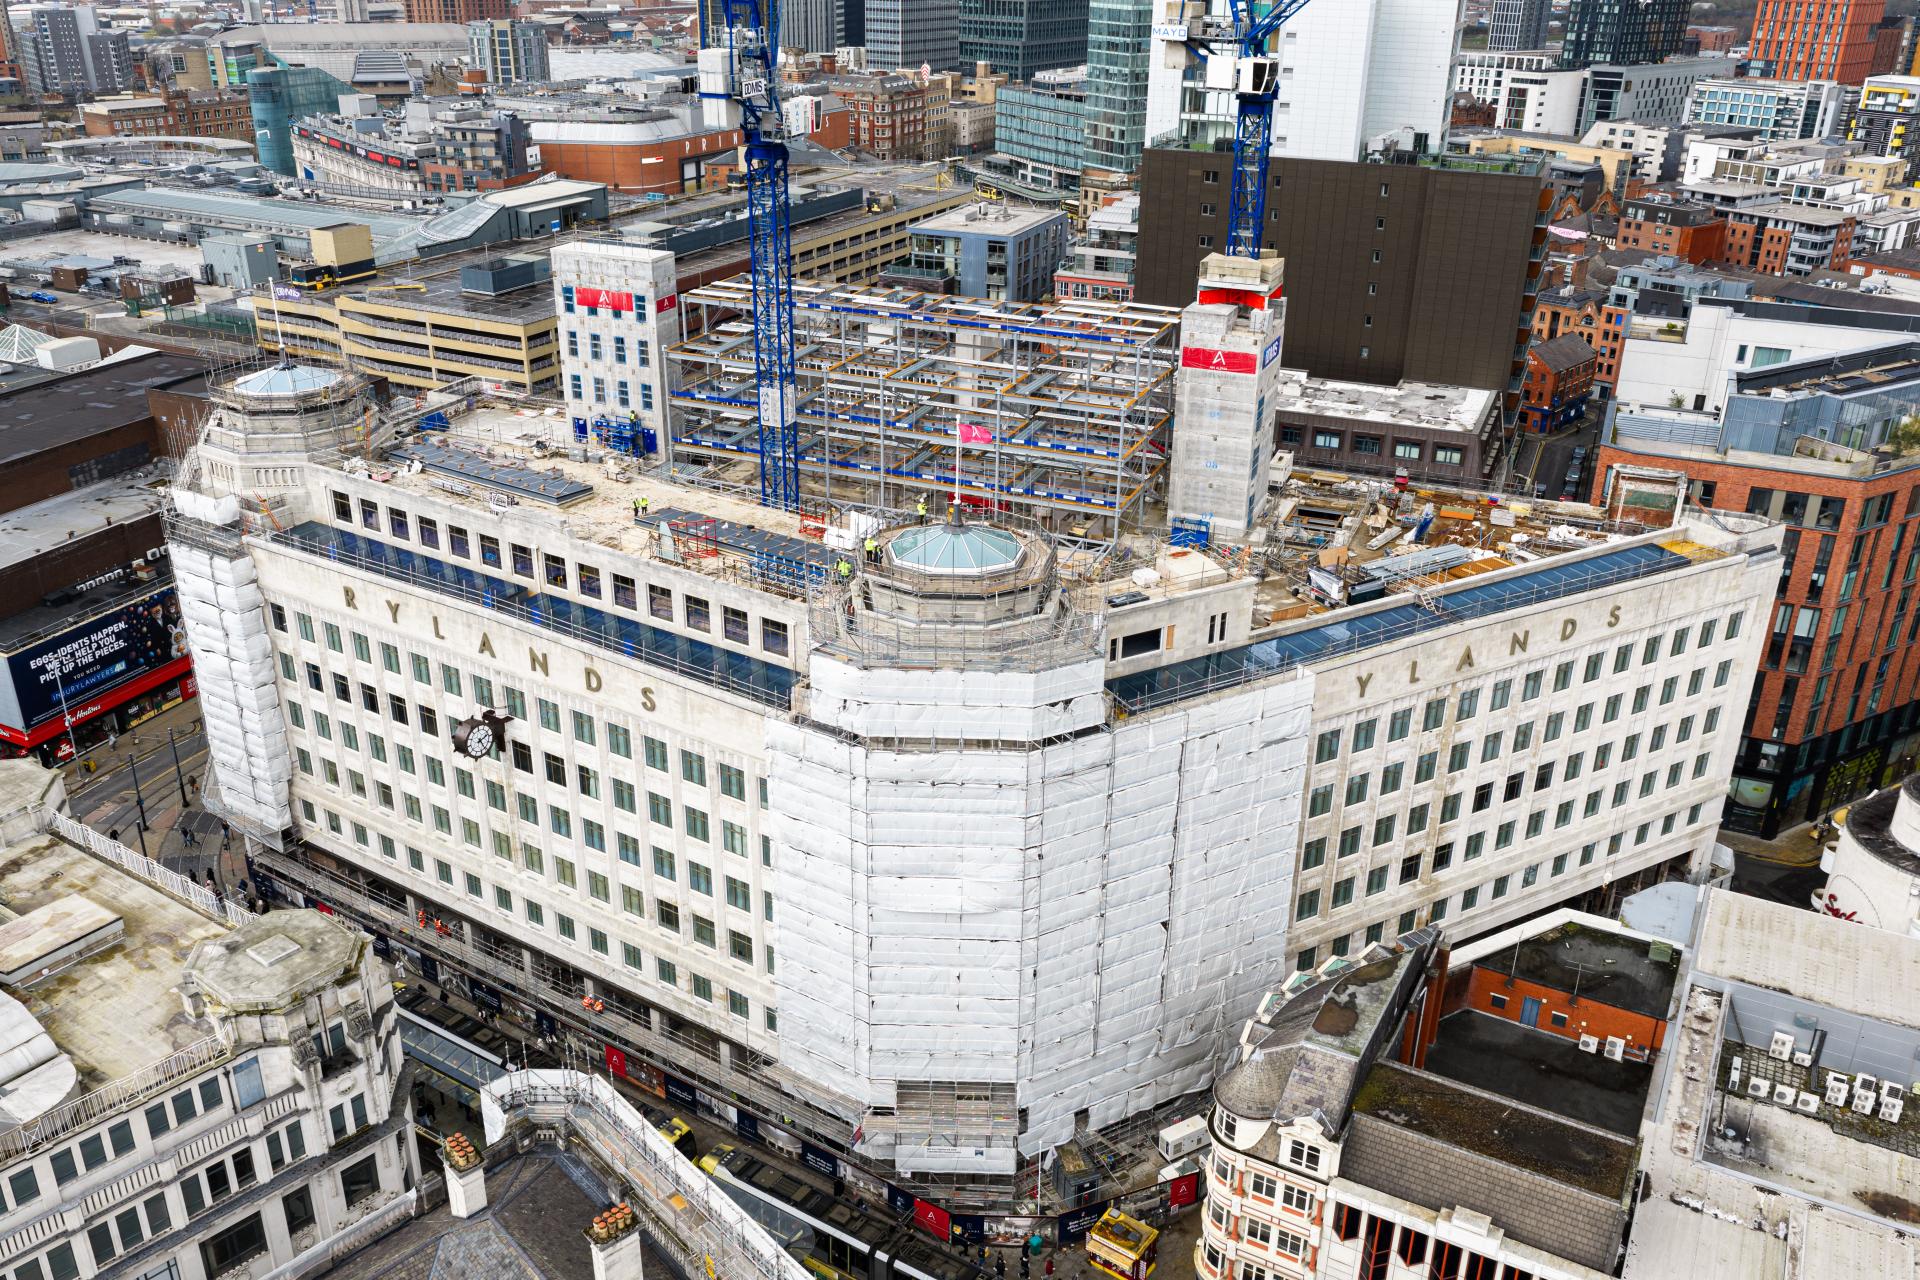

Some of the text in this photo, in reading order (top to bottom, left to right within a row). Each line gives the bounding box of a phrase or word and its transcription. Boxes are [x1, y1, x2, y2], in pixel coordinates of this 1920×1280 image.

[1152, 27, 1186, 37] MAYO
[74, 642, 98, 661] HELP
[98, 634, 116, 649] YOU
[90, 621, 128, 643] HAPPEN.
[343, 585, 656, 712] RYLANDS
[39, 639, 128, 684] PICK UP THE PIECES.
[1356, 605, 1622, 698] YLANDS
